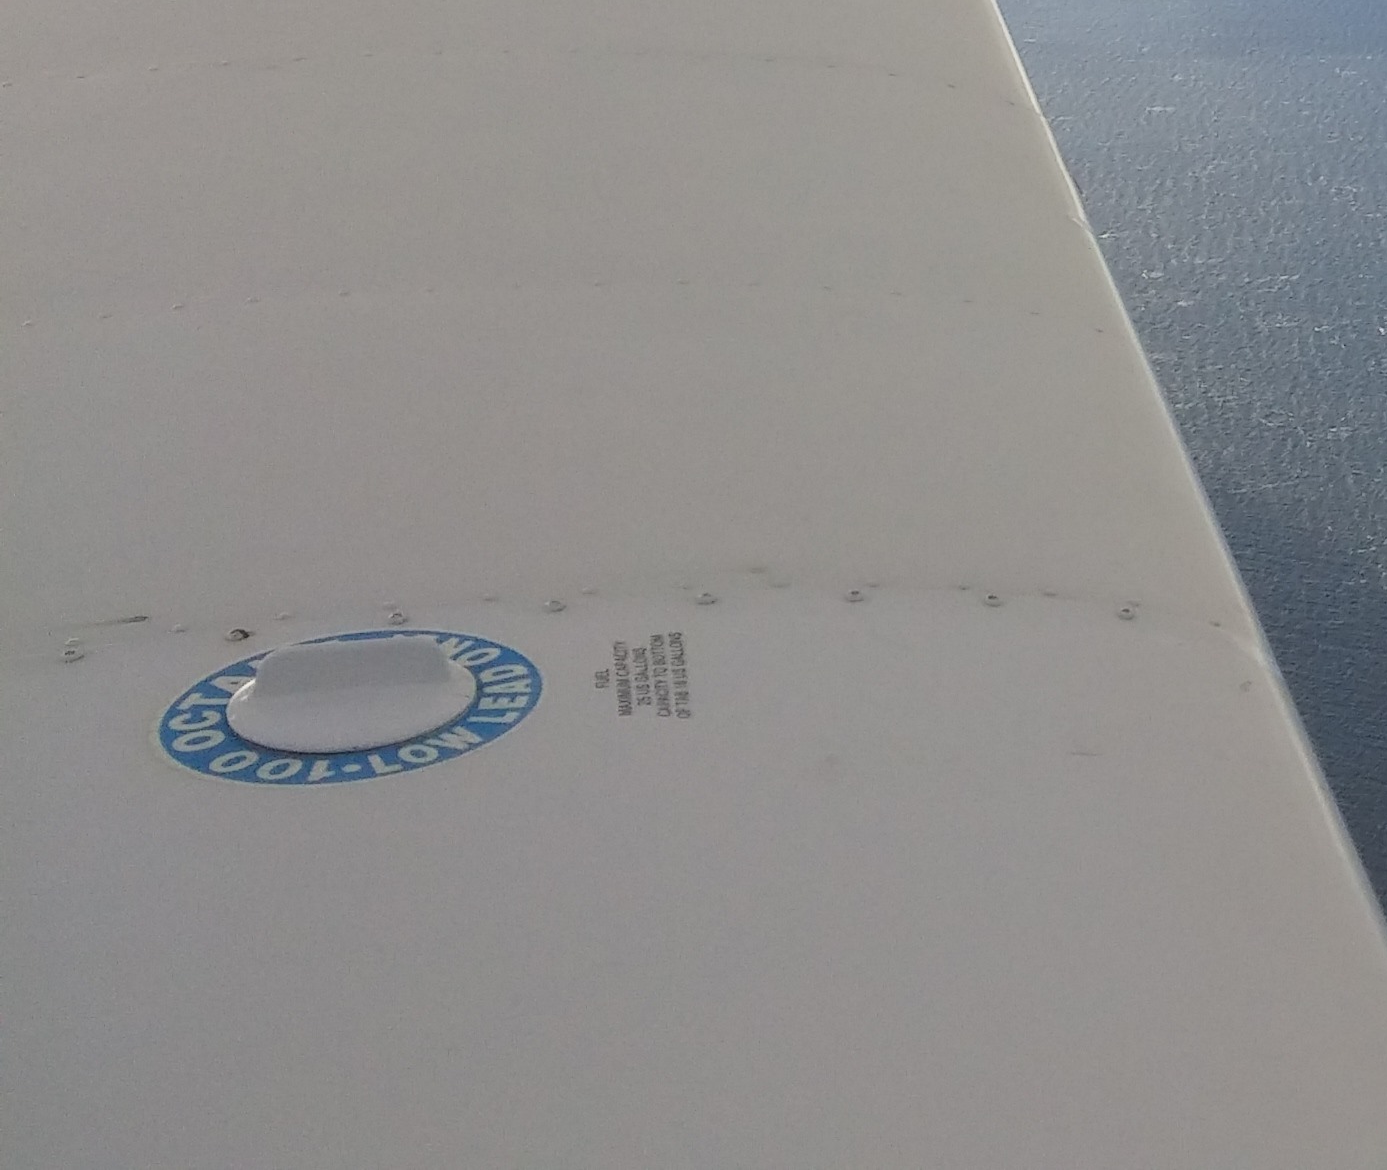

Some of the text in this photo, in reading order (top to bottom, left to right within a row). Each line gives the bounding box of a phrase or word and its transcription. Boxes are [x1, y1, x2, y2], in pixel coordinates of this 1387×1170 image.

[632, 648, 649, 682] GALLONS
[668, 632, 685, 667] GALLONS
[595, 669, 609, 689] FUEL
[613, 641, 632, 716] MAXIMUM CAPACITY
[635, 683, 650, 695] US
[650, 635, 671, 717] CAPACITY TO BOTTOM
[168, 659, 338, 781] 100 OCTA
[367, 725, 483, 775] LOW
[466, 663, 532, 724] LEAD
[675, 708, 691, 719] OF
